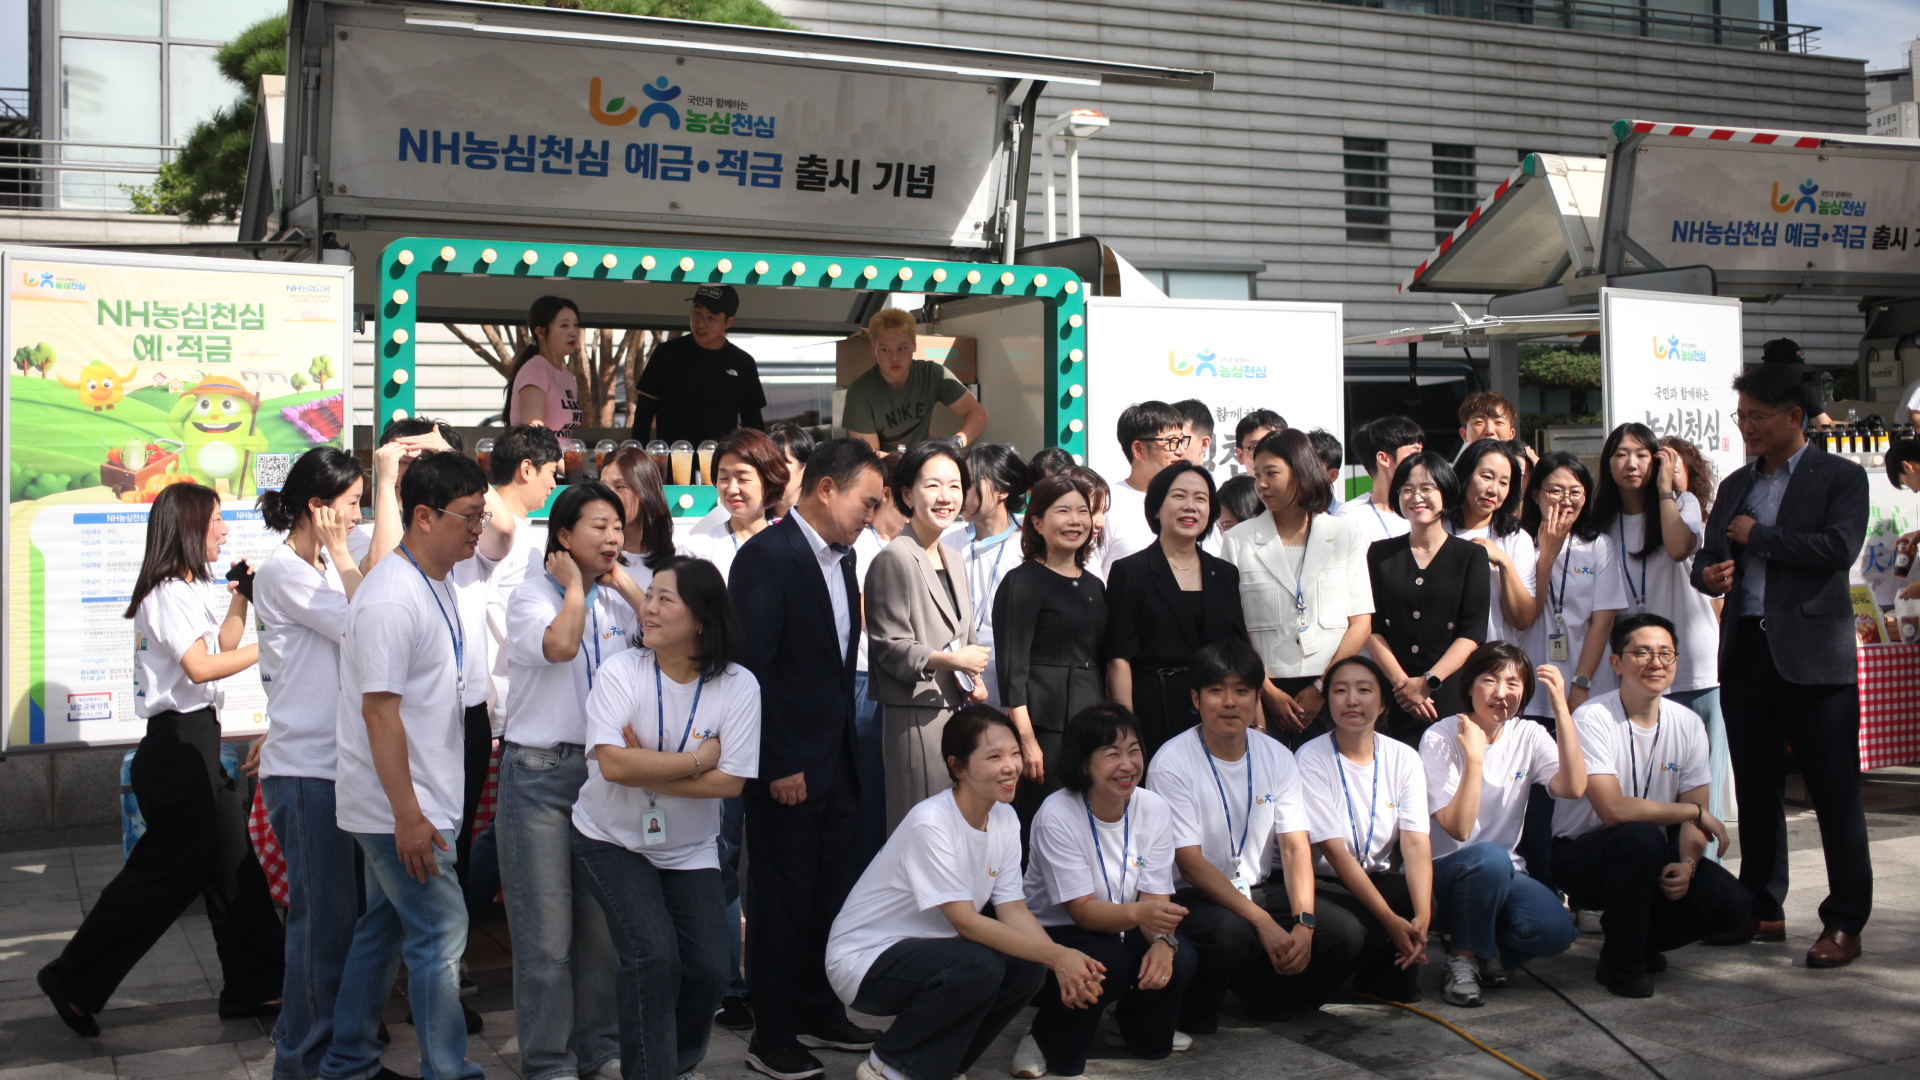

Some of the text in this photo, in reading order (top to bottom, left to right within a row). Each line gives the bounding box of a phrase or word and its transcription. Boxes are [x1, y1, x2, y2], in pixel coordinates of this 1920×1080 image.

[687, 95, 749, 111] 국민과 함께하는
[685, 109, 775, 139] 농심천심
[398, 127, 610, 178] NH농심천심
[795, 154, 860, 195] 출시
[872, 162, 937, 200] 기념
[1818, 199, 1866, 217] 농심천심
[1671, 220, 1779, 247] NH농심천심
[1872, 225, 1908, 251] 출시
[97, 298, 266, 330] NH농심천심
[1681, 349, 1706, 362] 농심천심
[1219, 364, 1266, 379] 농심천심
[1654, 386, 1709, 401] 국민과 함께하는
[885, 402, 925, 429] NIKE
[106, 513, 147, 523] NH농심천심
